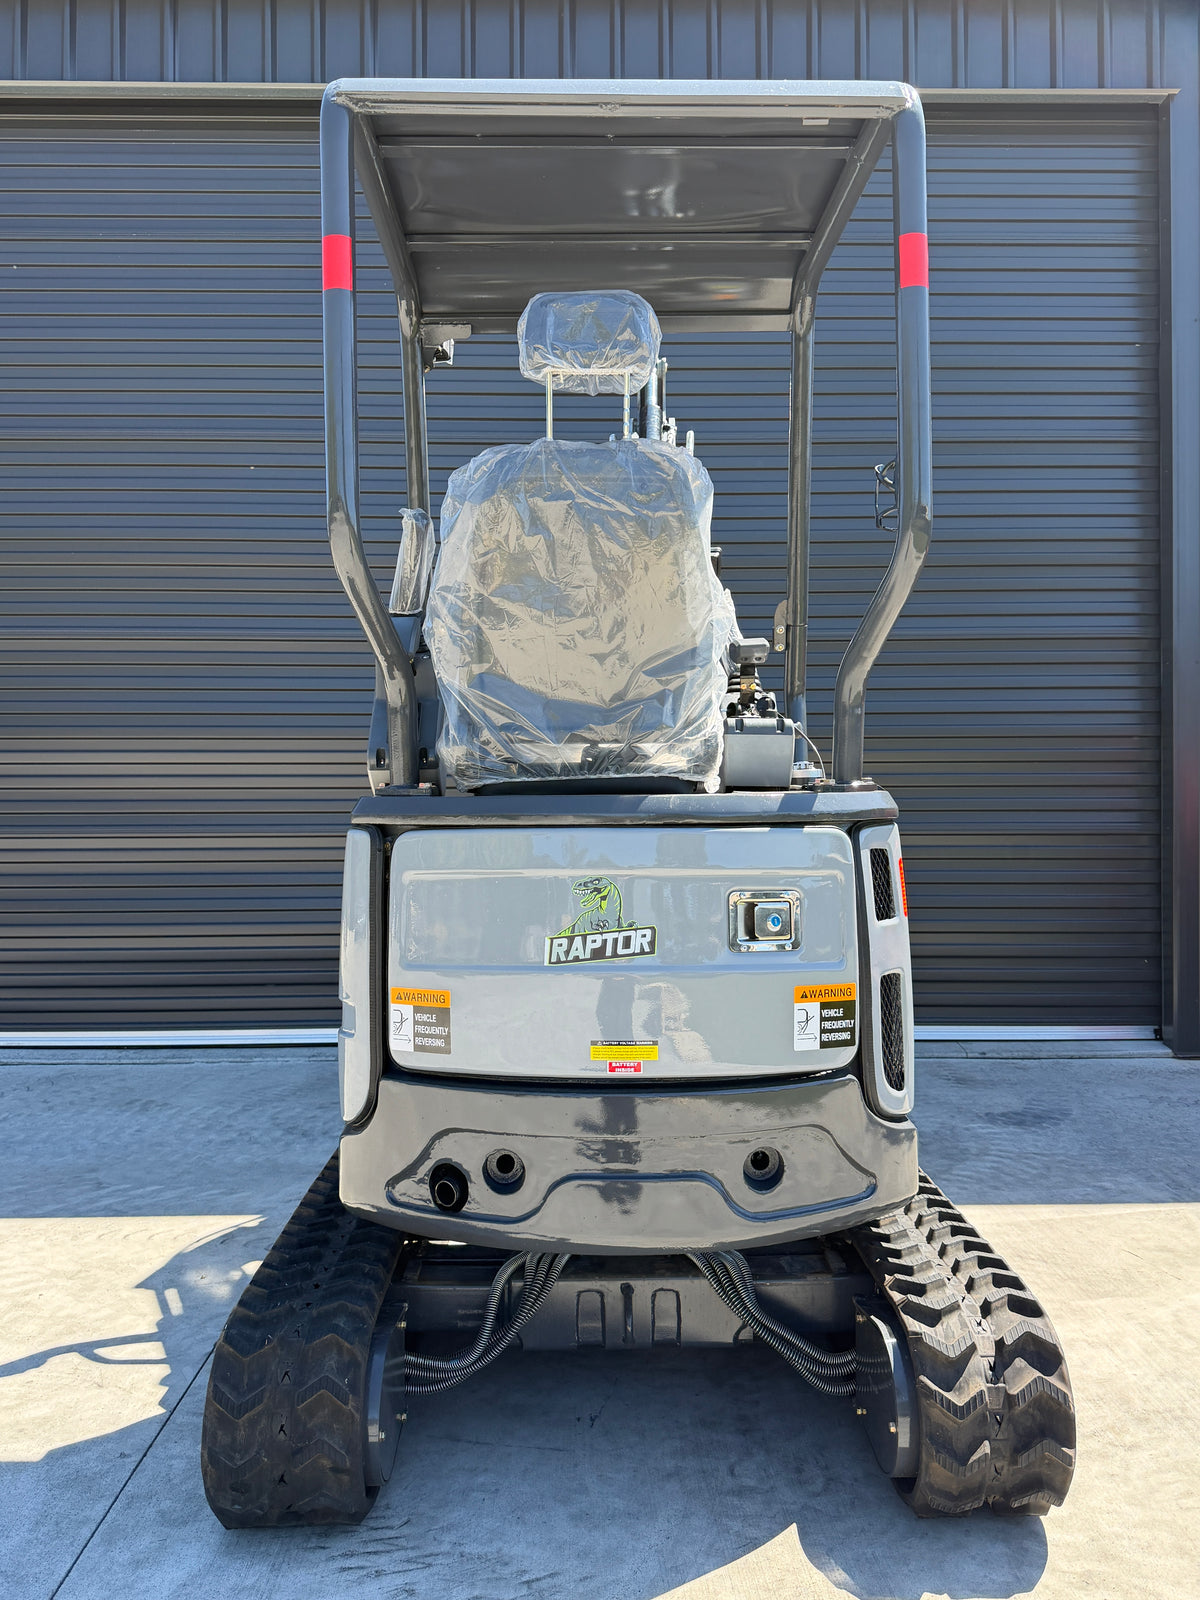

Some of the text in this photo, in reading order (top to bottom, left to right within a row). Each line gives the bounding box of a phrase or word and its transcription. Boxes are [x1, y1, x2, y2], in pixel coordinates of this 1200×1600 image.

[550, 928, 652, 963] RAPTOR
[402, 991, 446, 1004] WARNING
[808, 987, 852, 999] WARNING
[414, 1013, 437, 1023] VEHICLE
[821, 1008, 844, 1018] VEHICLE
[821, 1019, 855, 1030] FREQUENTLY
[414, 1025, 449, 1036] FREQUENTLY
[414, 1036, 446, 1047] REVERSING
[821, 1031, 851, 1042] REVERSING
